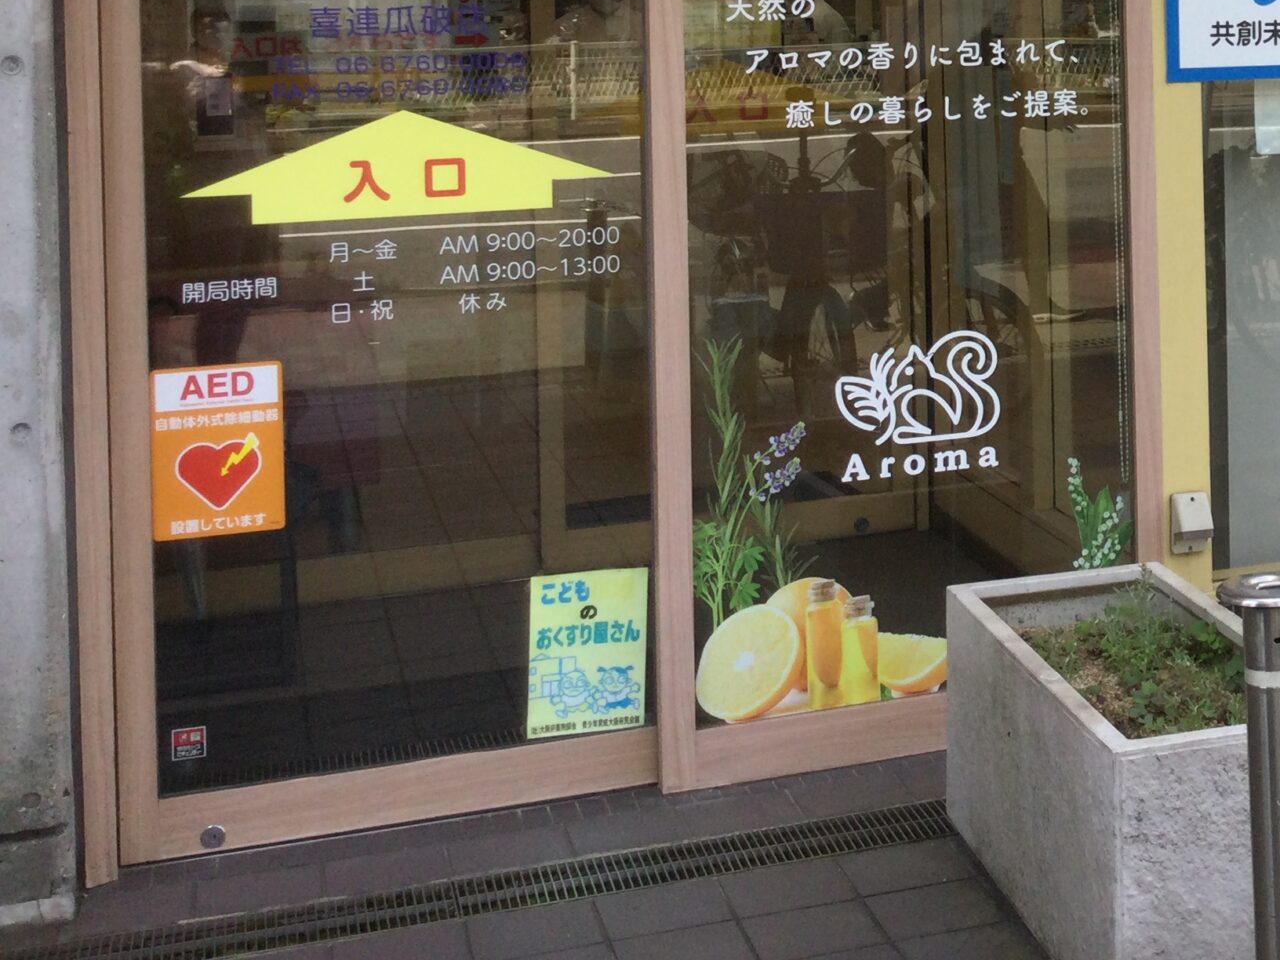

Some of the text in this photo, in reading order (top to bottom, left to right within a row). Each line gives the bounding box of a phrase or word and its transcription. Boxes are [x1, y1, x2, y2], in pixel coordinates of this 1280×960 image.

[744, 38, 1081, 75] アロマの香りに包まれて、
[785, 90, 1090, 130] 癒しの暮らしをご提案。
[343, 157, 467, 204] 入口
[439, 235, 480, 256] AM
[181, 276, 278, 305] 開局時間
[352, 271, 376, 293] 土
[439, 264, 480, 285] AM
[179, 370, 255, 401] AED
[841, 443, 1000, 483] Aroma
[541, 580, 590, 605] こども
[579, 605, 598, 620] の
[536, 619, 641, 651] おくすり屋さん
